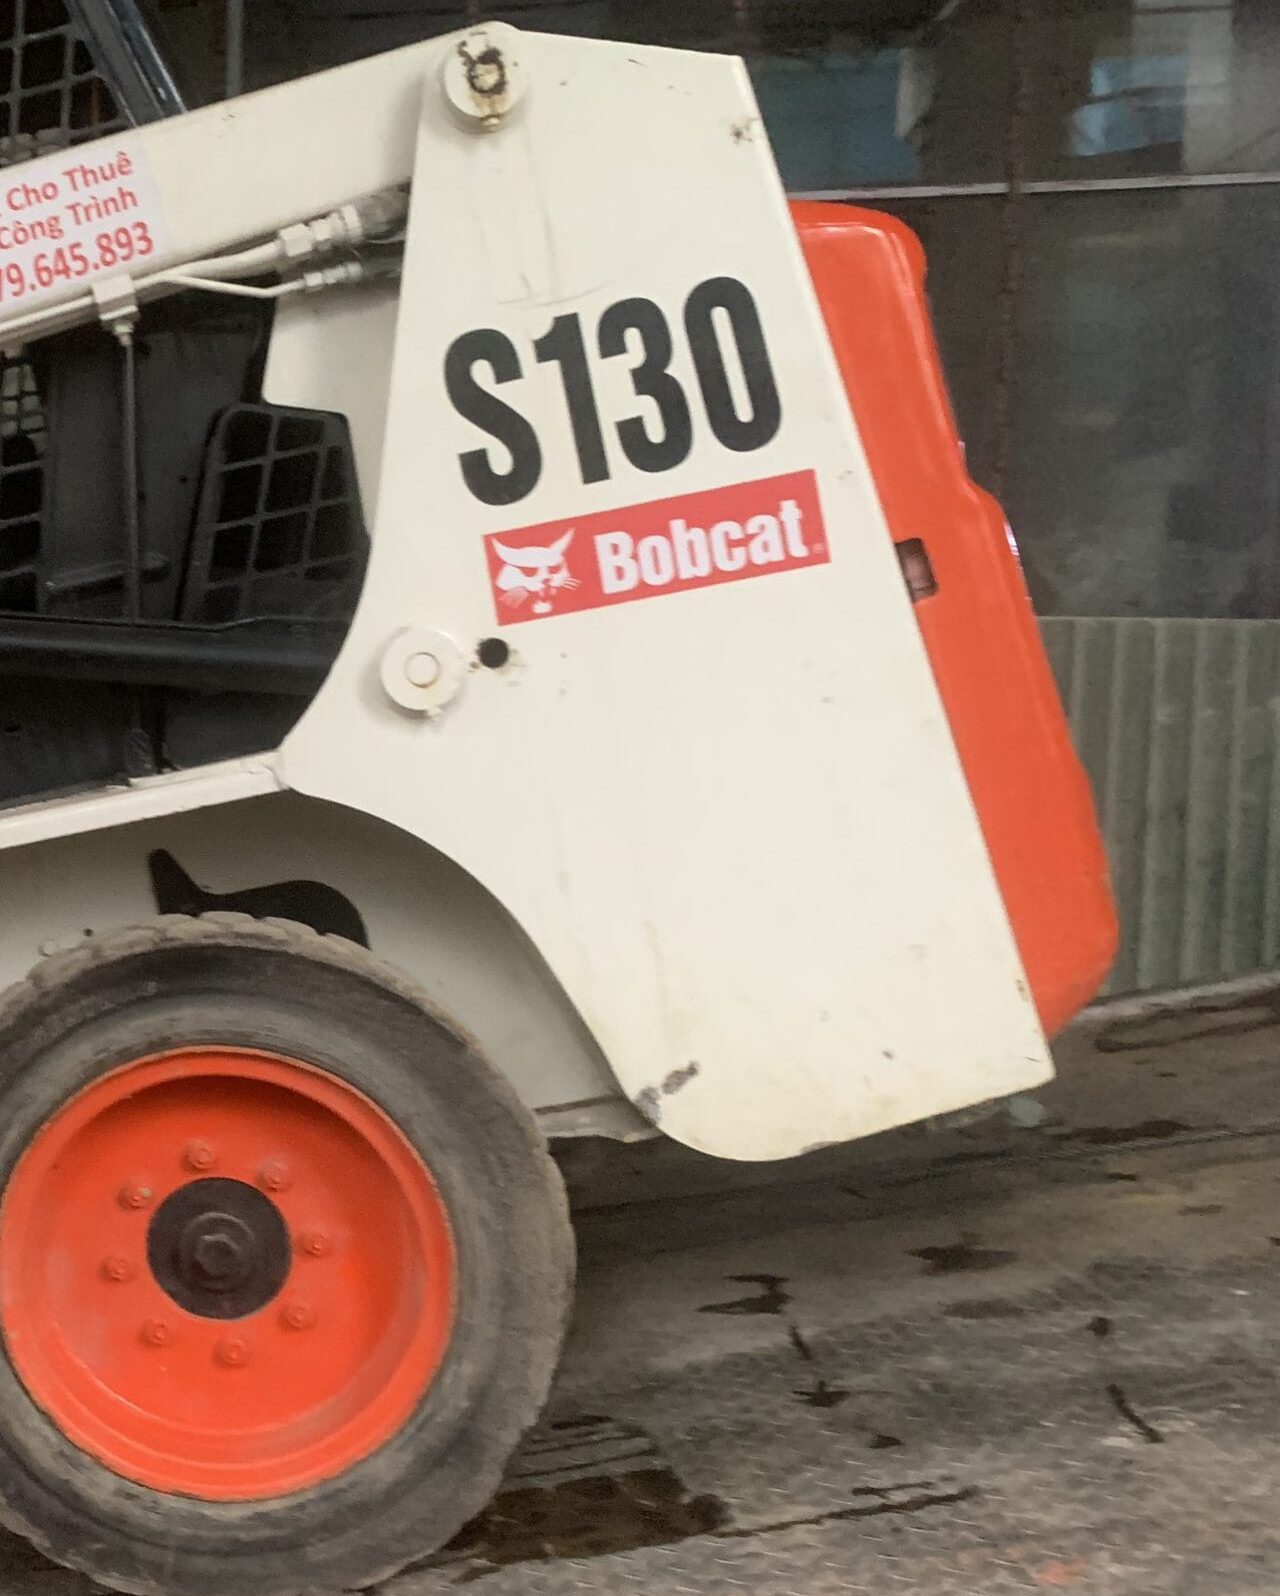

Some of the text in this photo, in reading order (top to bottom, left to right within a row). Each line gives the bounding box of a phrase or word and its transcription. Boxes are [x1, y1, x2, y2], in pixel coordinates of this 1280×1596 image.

[6, 181, 59, 211] Cho
[62, 151, 133, 192] Thuê
[65, 187, 139, 225] Trình
[443, 276, 781, 507] S130
[593, 499, 809, 595] Bobcat
